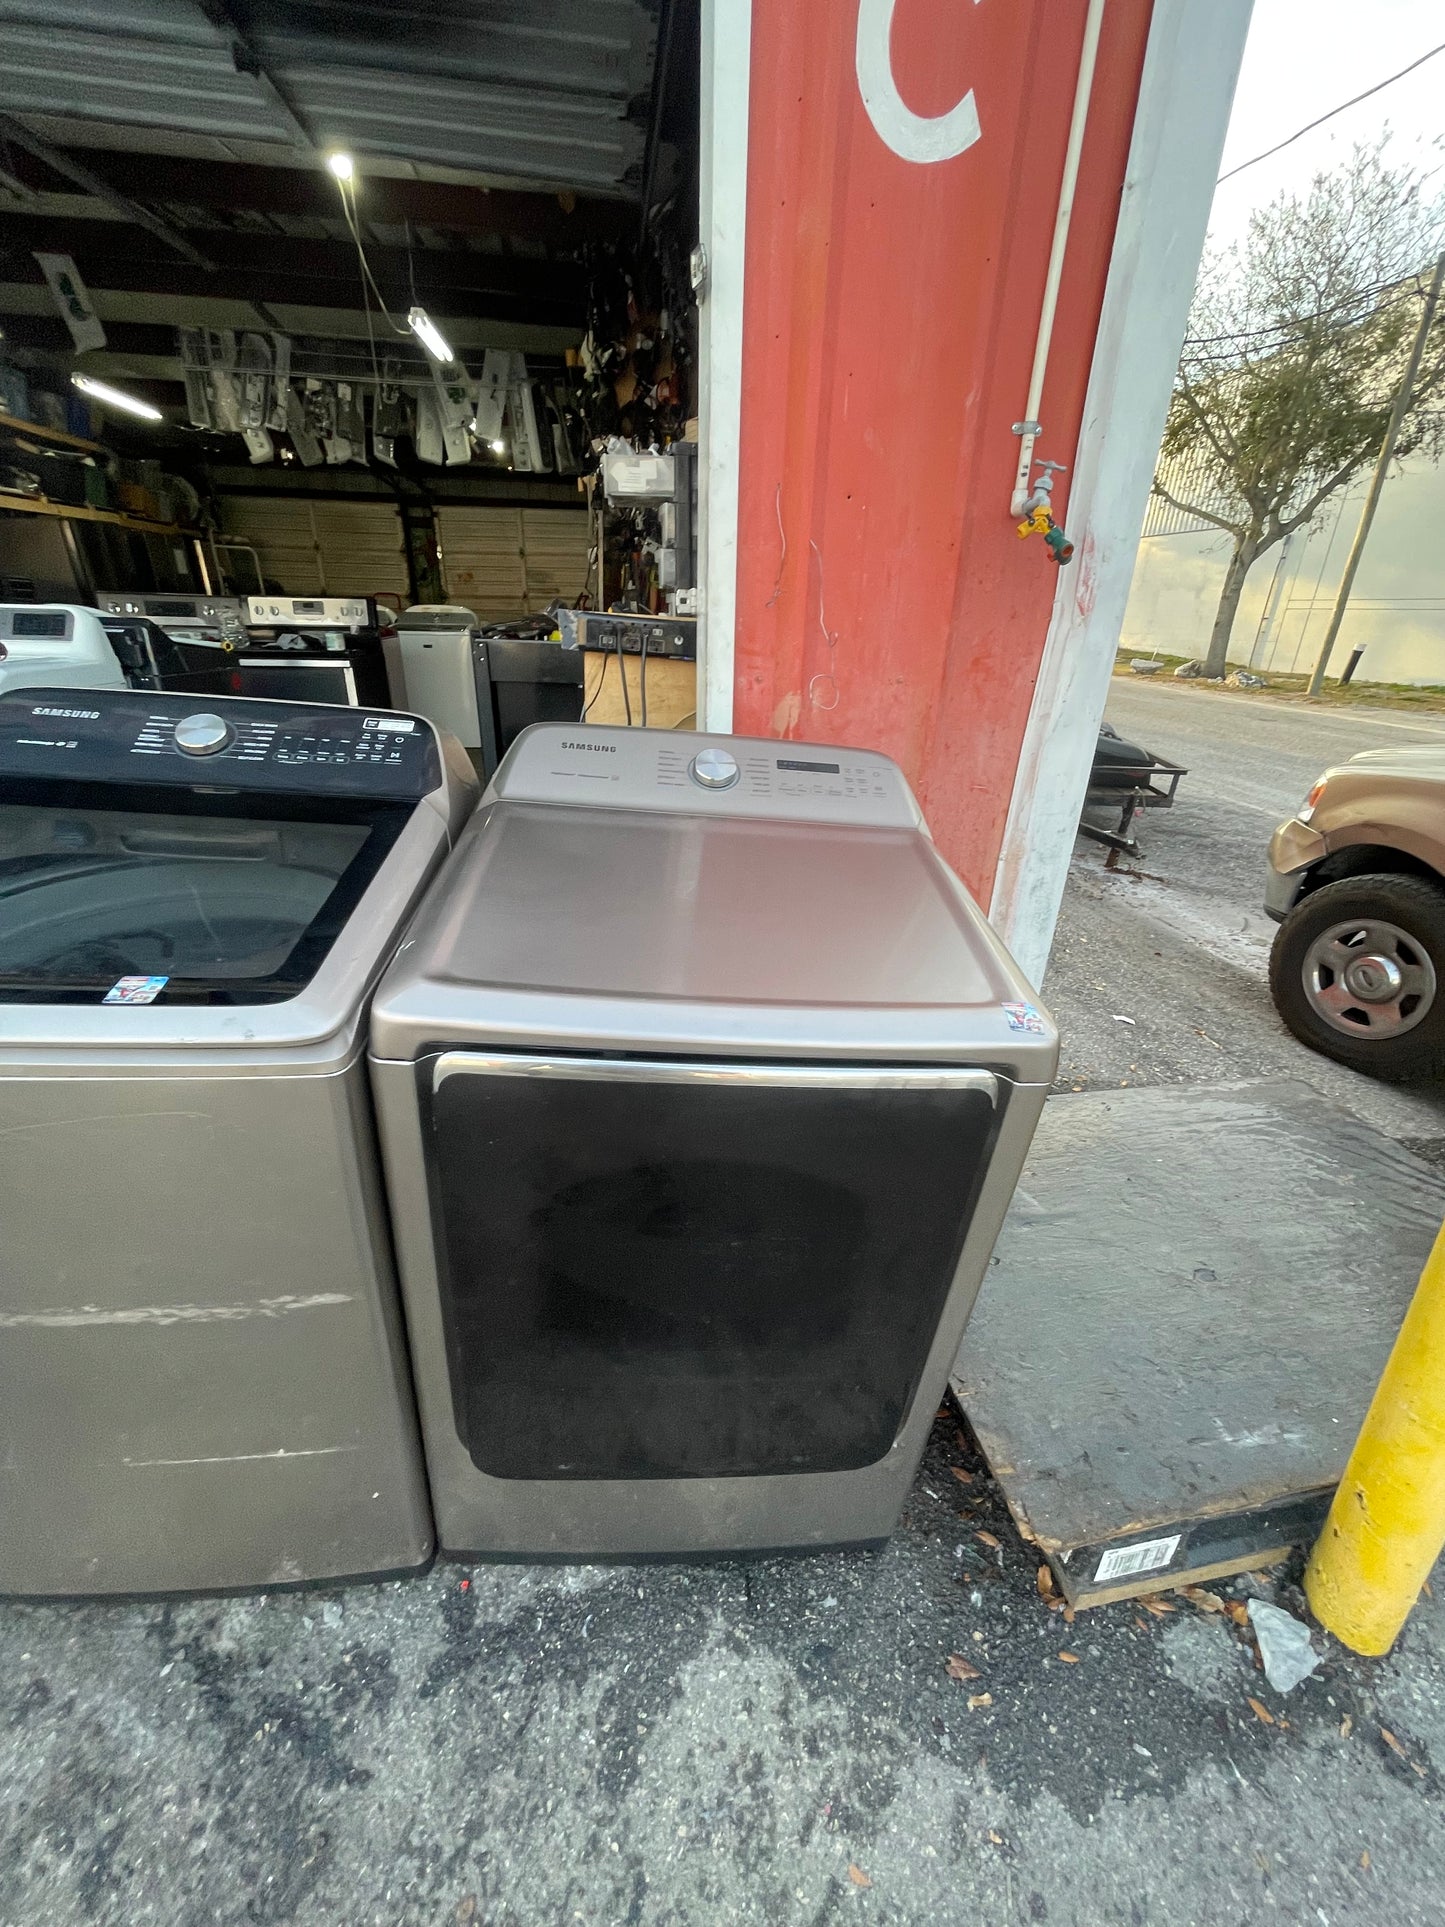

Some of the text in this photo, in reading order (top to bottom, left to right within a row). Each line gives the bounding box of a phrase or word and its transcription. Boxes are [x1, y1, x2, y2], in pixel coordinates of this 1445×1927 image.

[855, 0, 982, 163] C
[32, 707, 100, 719] SAMSUNG
[561, 742, 617, 753] SAMSUNG
